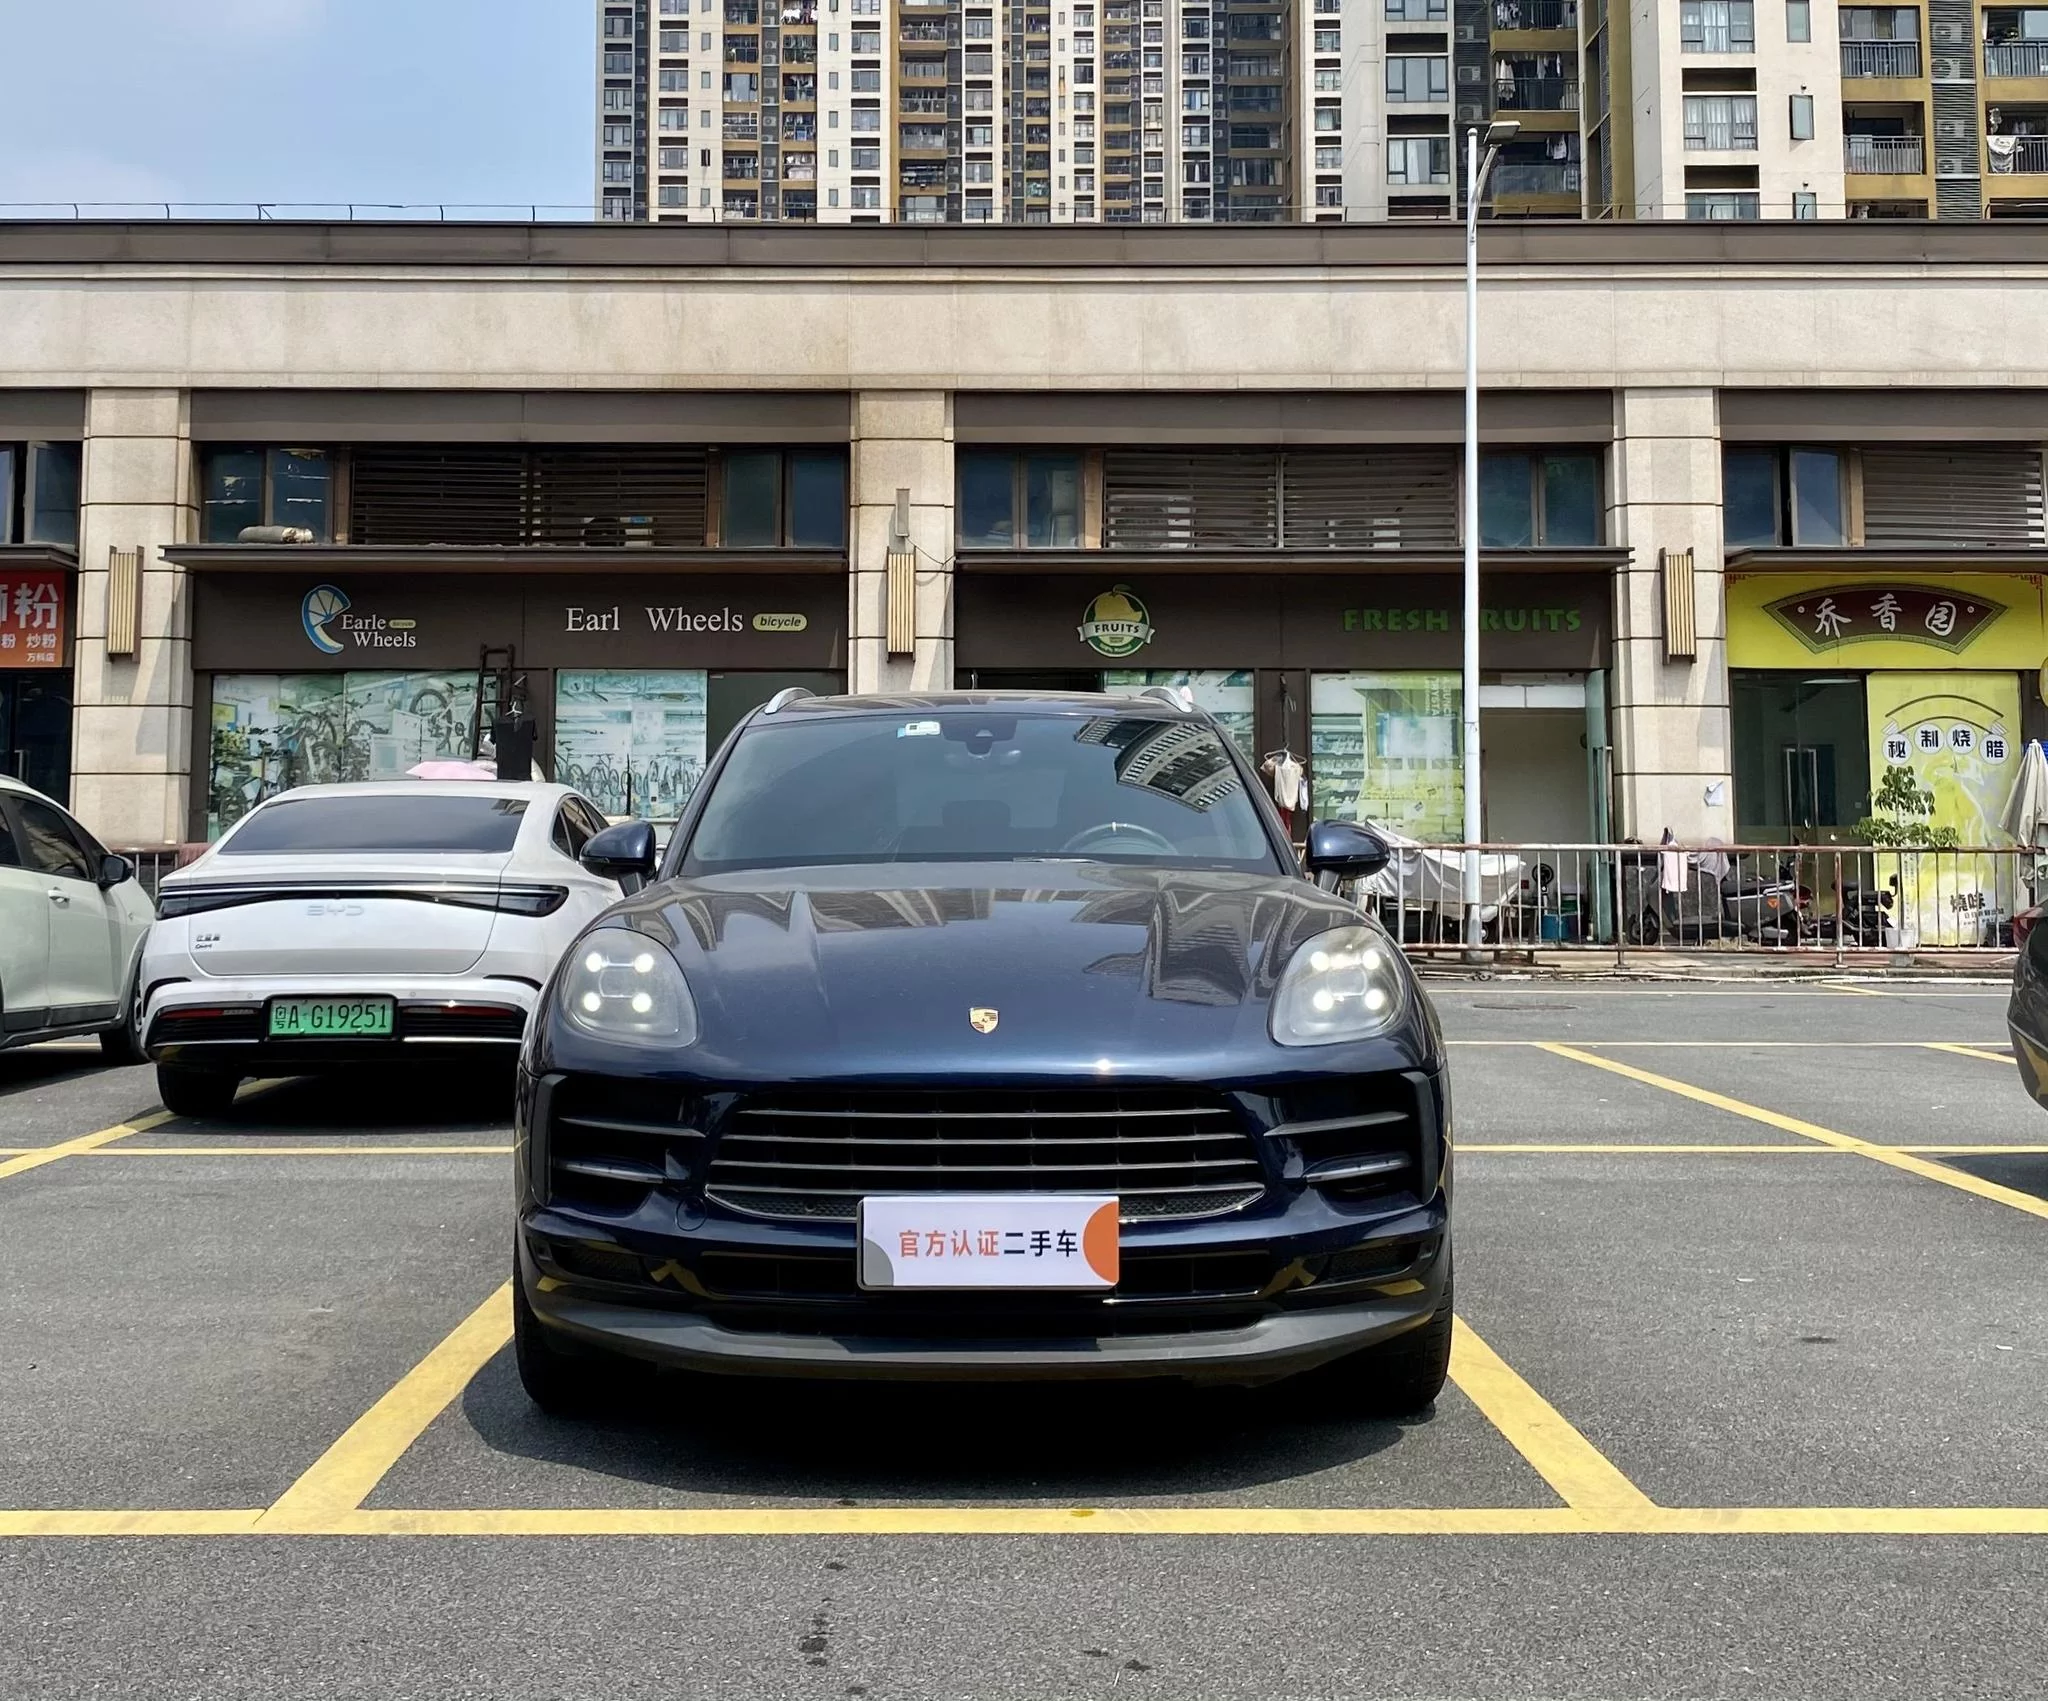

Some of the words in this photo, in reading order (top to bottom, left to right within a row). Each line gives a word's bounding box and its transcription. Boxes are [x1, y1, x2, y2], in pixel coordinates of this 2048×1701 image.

[341, 614, 386, 630] Earle
[565, 607, 620, 632] Earl
[645, 607, 743, 632] Wheels
[760, 616, 801, 627] bicycle
[1094, 623, 1140, 634] FRUITS
[1343, 609, 1449, 631] FRESH
[1461, 609, 1581, 631] RUITS
[26, 633, 56, 649] 炒粉
[353, 631, 417, 647] Wheels
[1887, 729, 2004, 759] 秘制烧腊
[307, 904, 365, 916] BYD
[311, 1004, 387, 1029] G19251
[898, 1229, 1078, 1258] 官方认证二手车
